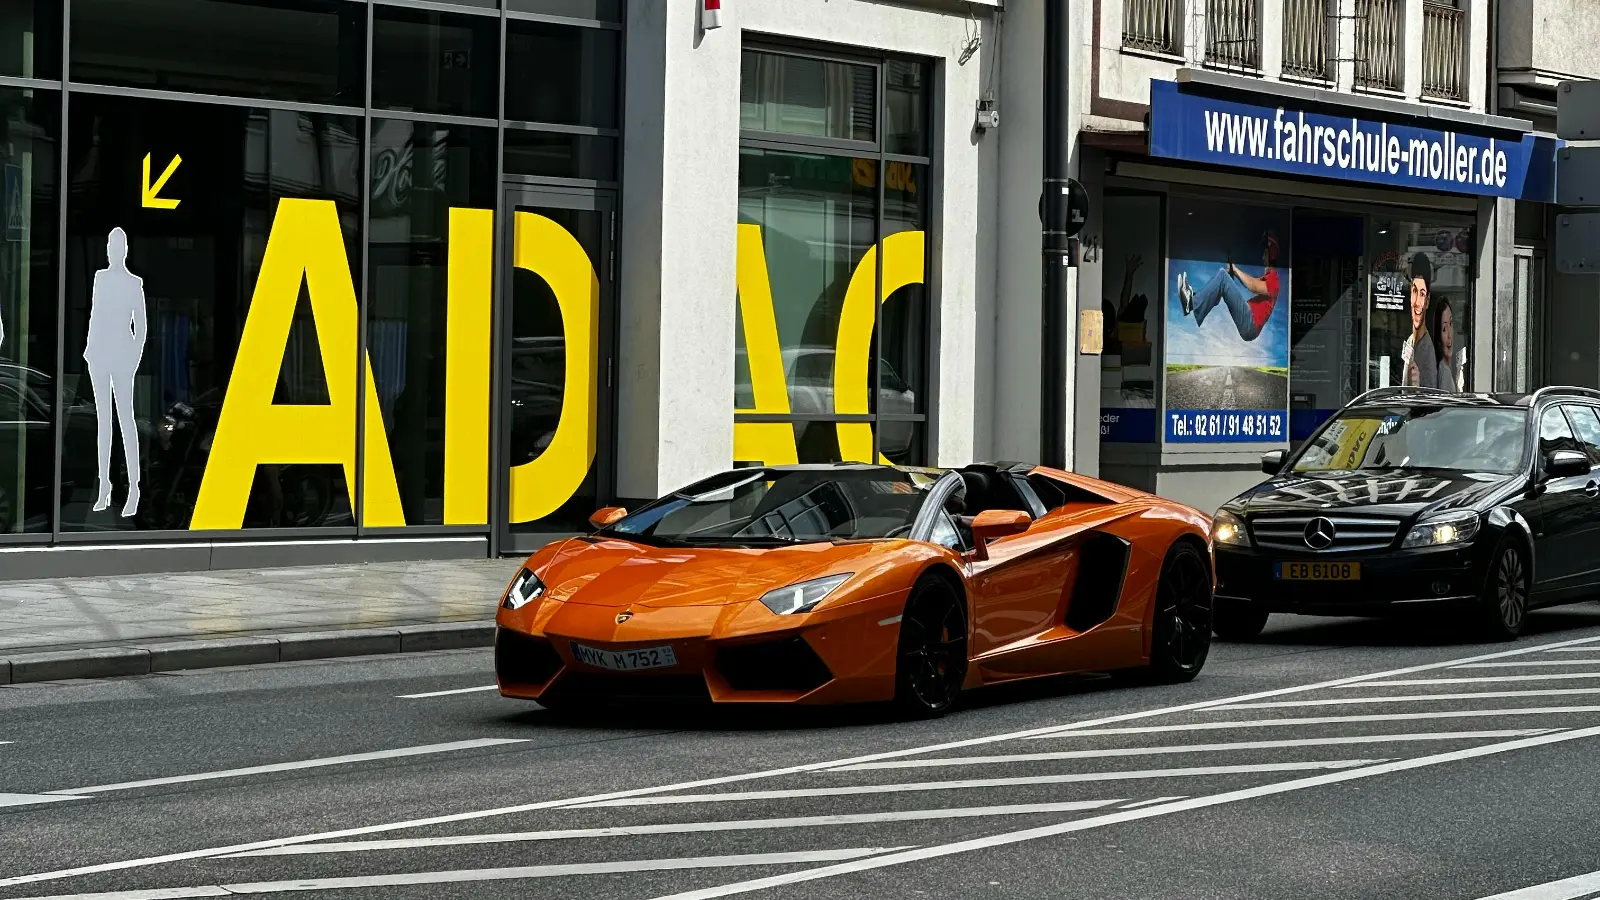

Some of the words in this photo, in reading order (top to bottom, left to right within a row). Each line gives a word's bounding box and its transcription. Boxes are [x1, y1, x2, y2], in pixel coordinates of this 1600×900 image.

[1204, 106, 1508, 188] www.fahrschule-moller.de
[1293, 312, 1322, 325] SHOP
[1171, 414, 1193, 436] Tel.:
[1195, 414, 1208, 436] 02
[1209, 414, 1221, 436] 61
[1222, 414, 1228, 436] /
[1228, 414, 1240, 436] 91
[1242, 414, 1254, 436] 48
[1256, 414, 1267, 436] 51
[1269, 414, 1281, 436] 52
[1290, 563, 1309, 579] EB
[1312, 563, 1351, 579] 6108
[579, 646, 608, 667] MYK
[613, 654, 627, 669] M
[627, 650, 662, 669] 752
